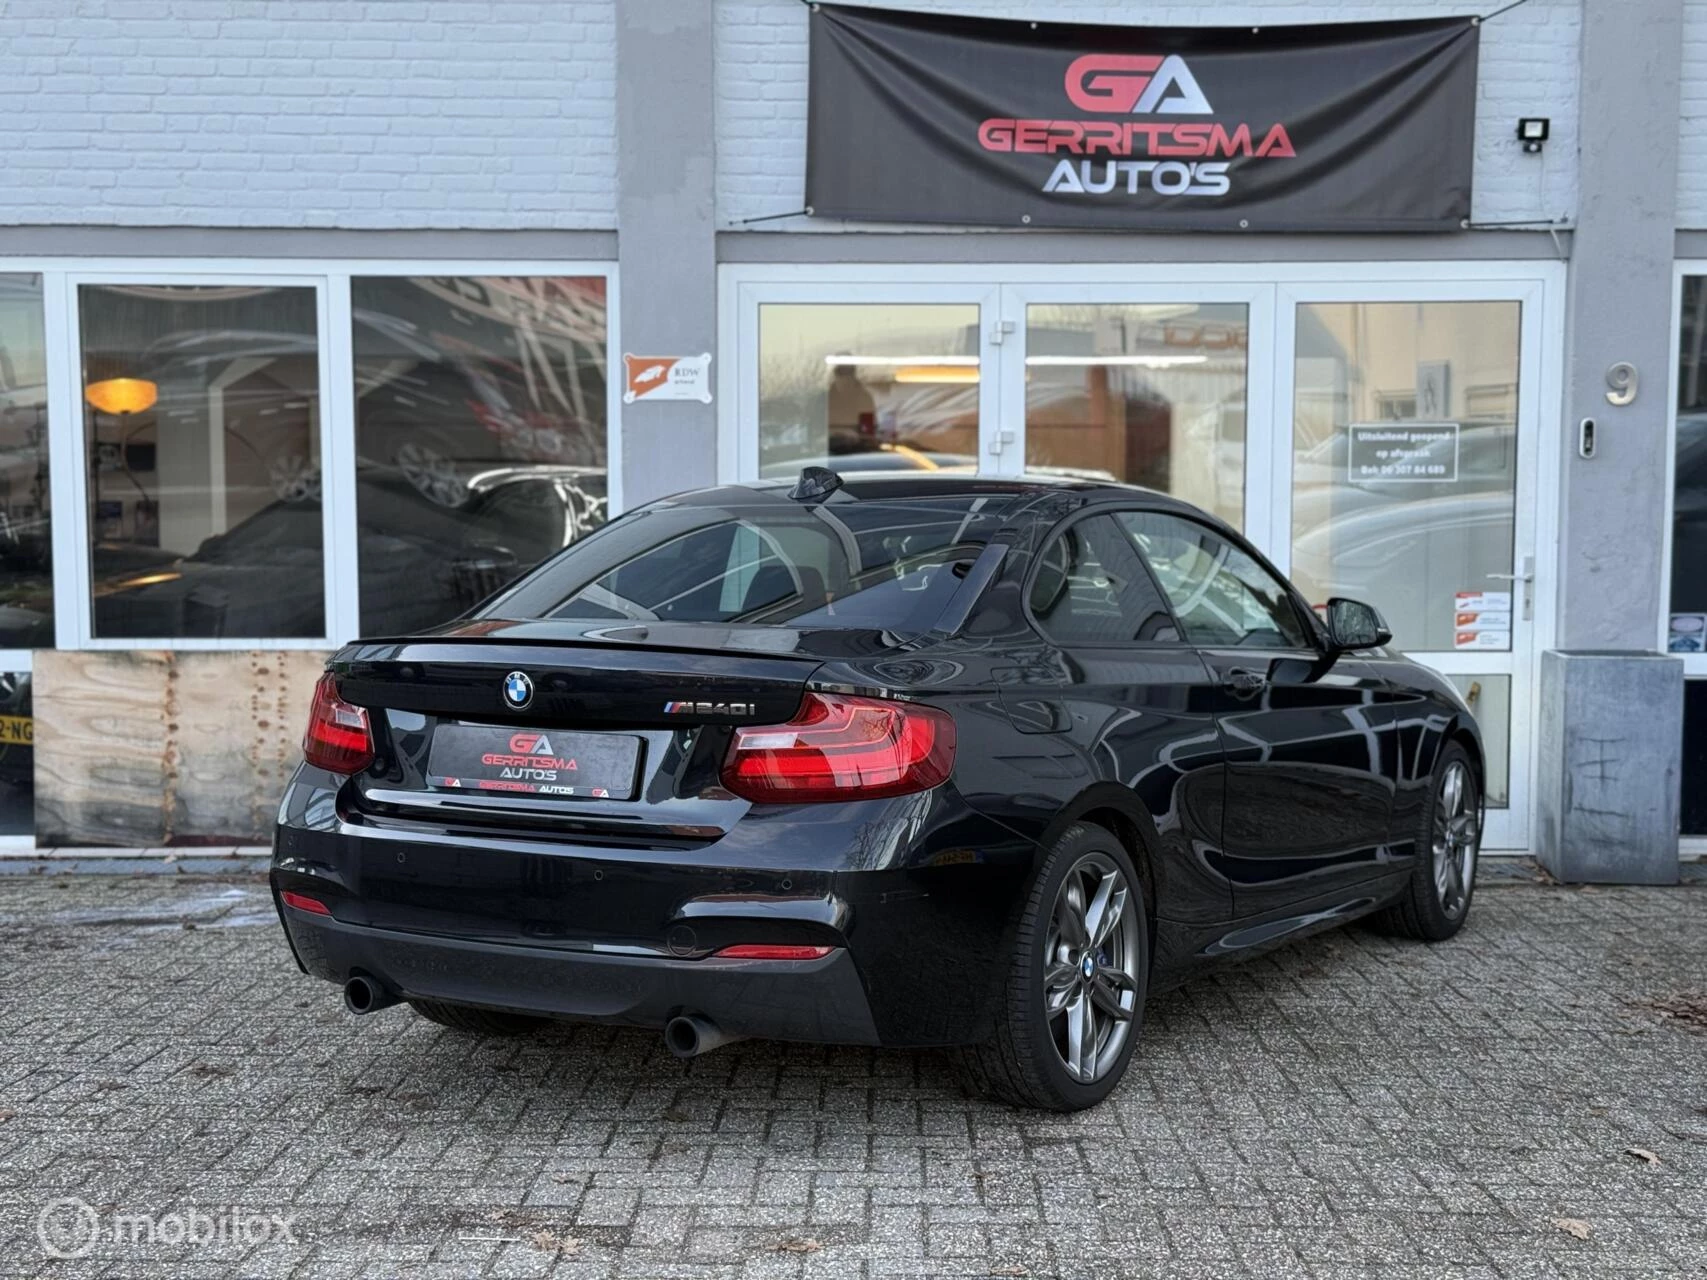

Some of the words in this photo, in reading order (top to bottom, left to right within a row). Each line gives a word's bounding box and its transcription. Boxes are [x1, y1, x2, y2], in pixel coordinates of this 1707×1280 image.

[1064, 53, 1214, 114] GA
[977, 118, 1297, 158] GERRITSMA
[1041, 159, 1231, 196] AUTO'S
[674, 367, 700, 377] RDW
[1605, 360, 1638, 406] 9
[1375, 450, 1389, 460] op
[509, 733, 554, 755] GA
[481, 754, 578, 771] GERRITSMA
